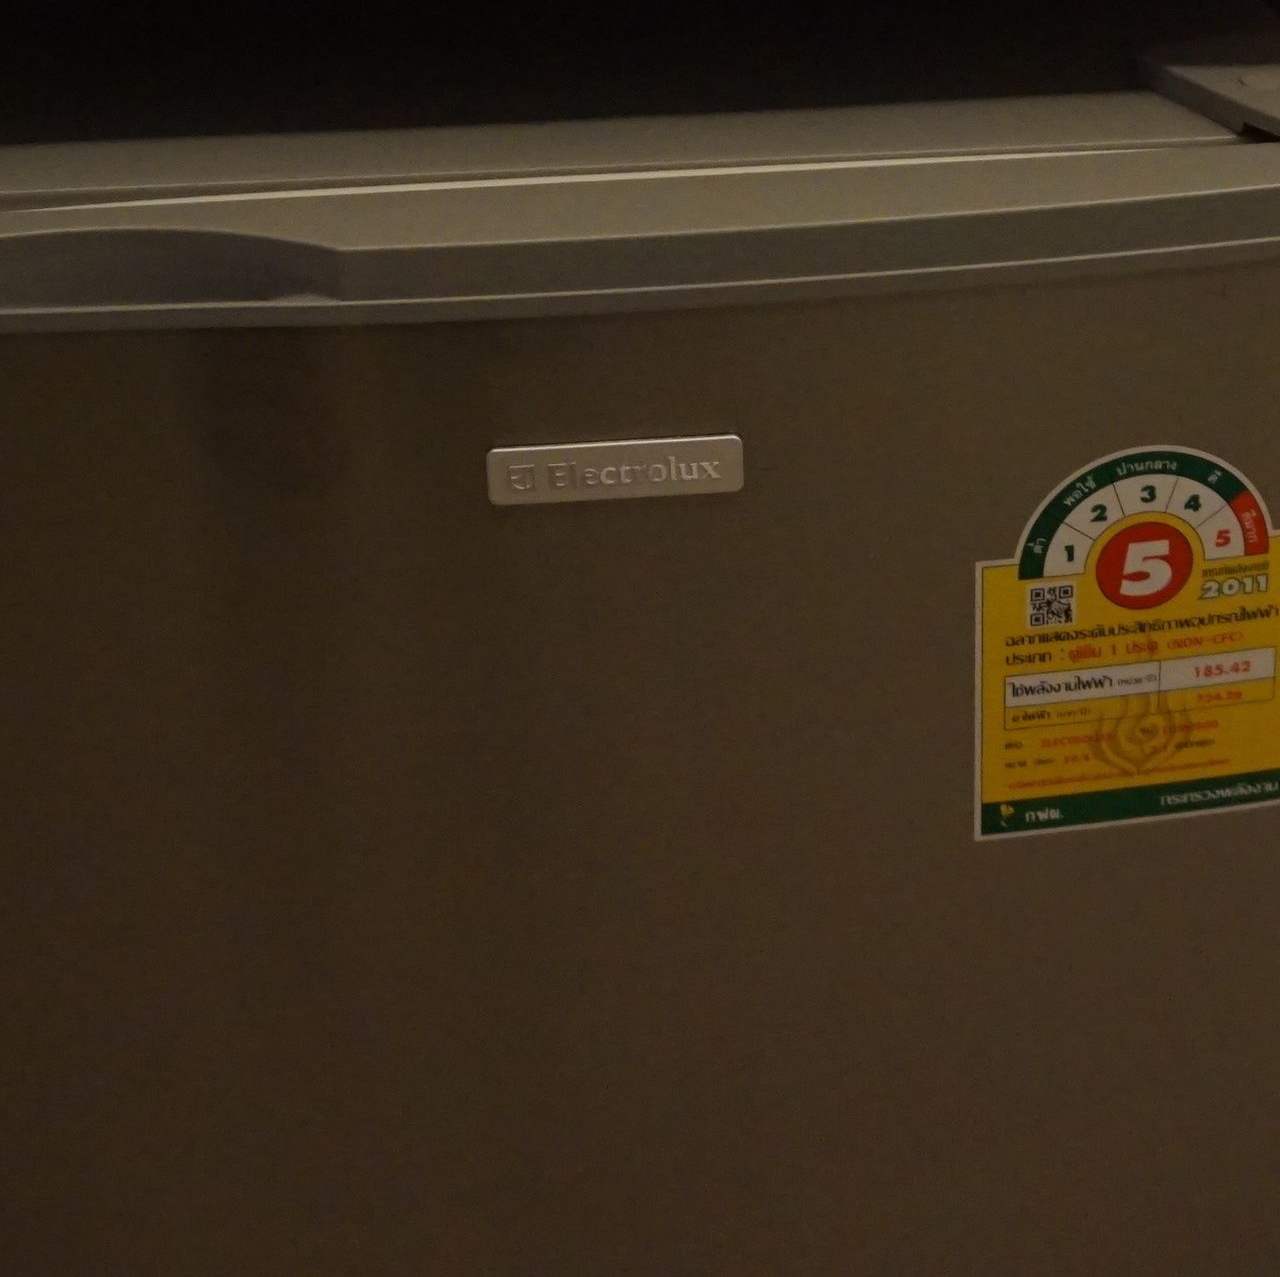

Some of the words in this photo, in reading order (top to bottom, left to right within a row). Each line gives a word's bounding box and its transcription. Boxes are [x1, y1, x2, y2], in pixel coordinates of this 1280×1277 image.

[547, 456, 722, 488] Electrolux
[1115, 458, 1178, 477] ปานกลาง
[1064, 545, 1074, 562] 1
[1091, 504, 1108, 523] 2
[1140, 485, 1157, 503] 3
[1184, 494, 1202, 512] 4
[1215, 529, 1231, 547] 5
[1120, 538, 1173, 597] 5
[1199, 573, 1270, 600] 2011
